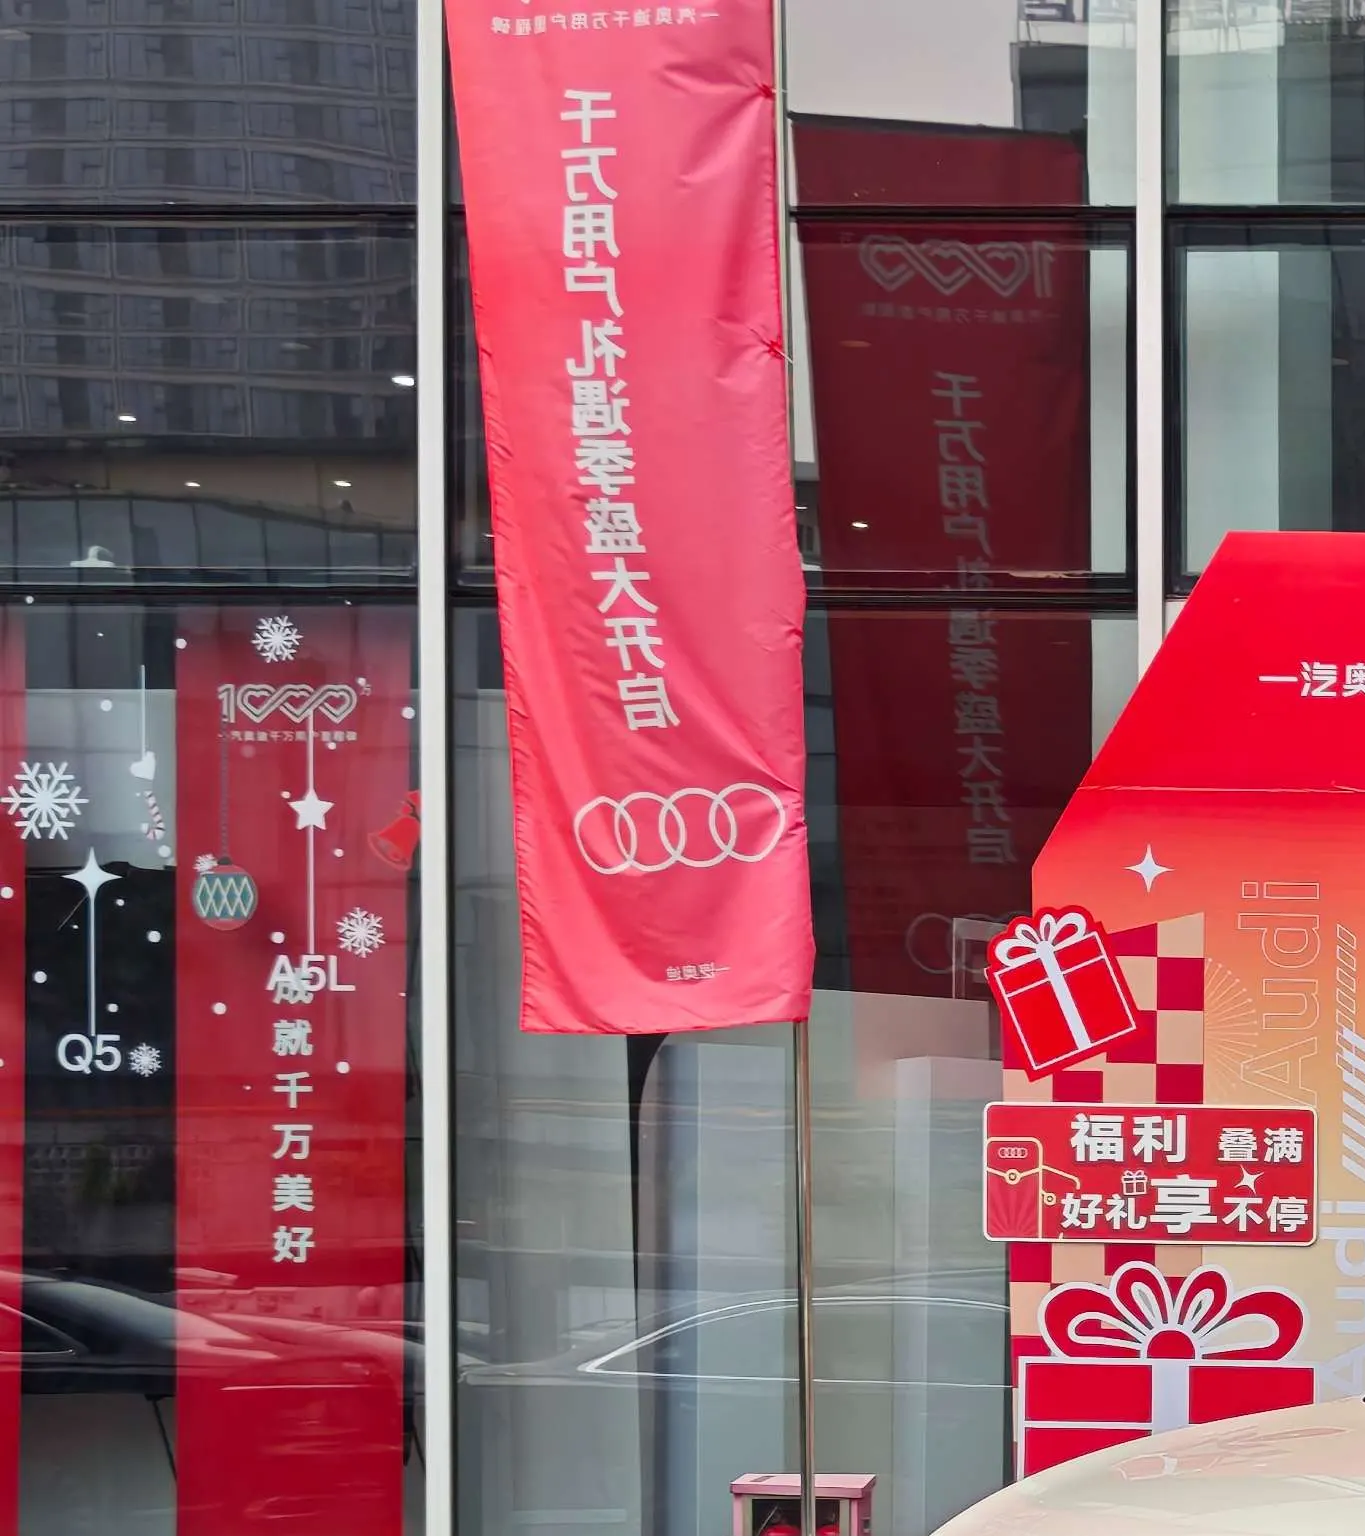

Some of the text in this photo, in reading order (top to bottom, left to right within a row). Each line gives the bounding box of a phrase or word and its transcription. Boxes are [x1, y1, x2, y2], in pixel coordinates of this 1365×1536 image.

[264, 954, 356, 991] A5L
[1238, 880, 1322, 1106] Audi
[57, 1033, 123, 1075] Q5
[1070, 1113, 1303, 1163] 福利 叠满
[1061, 1175, 1310, 1234] 好礼享不停
